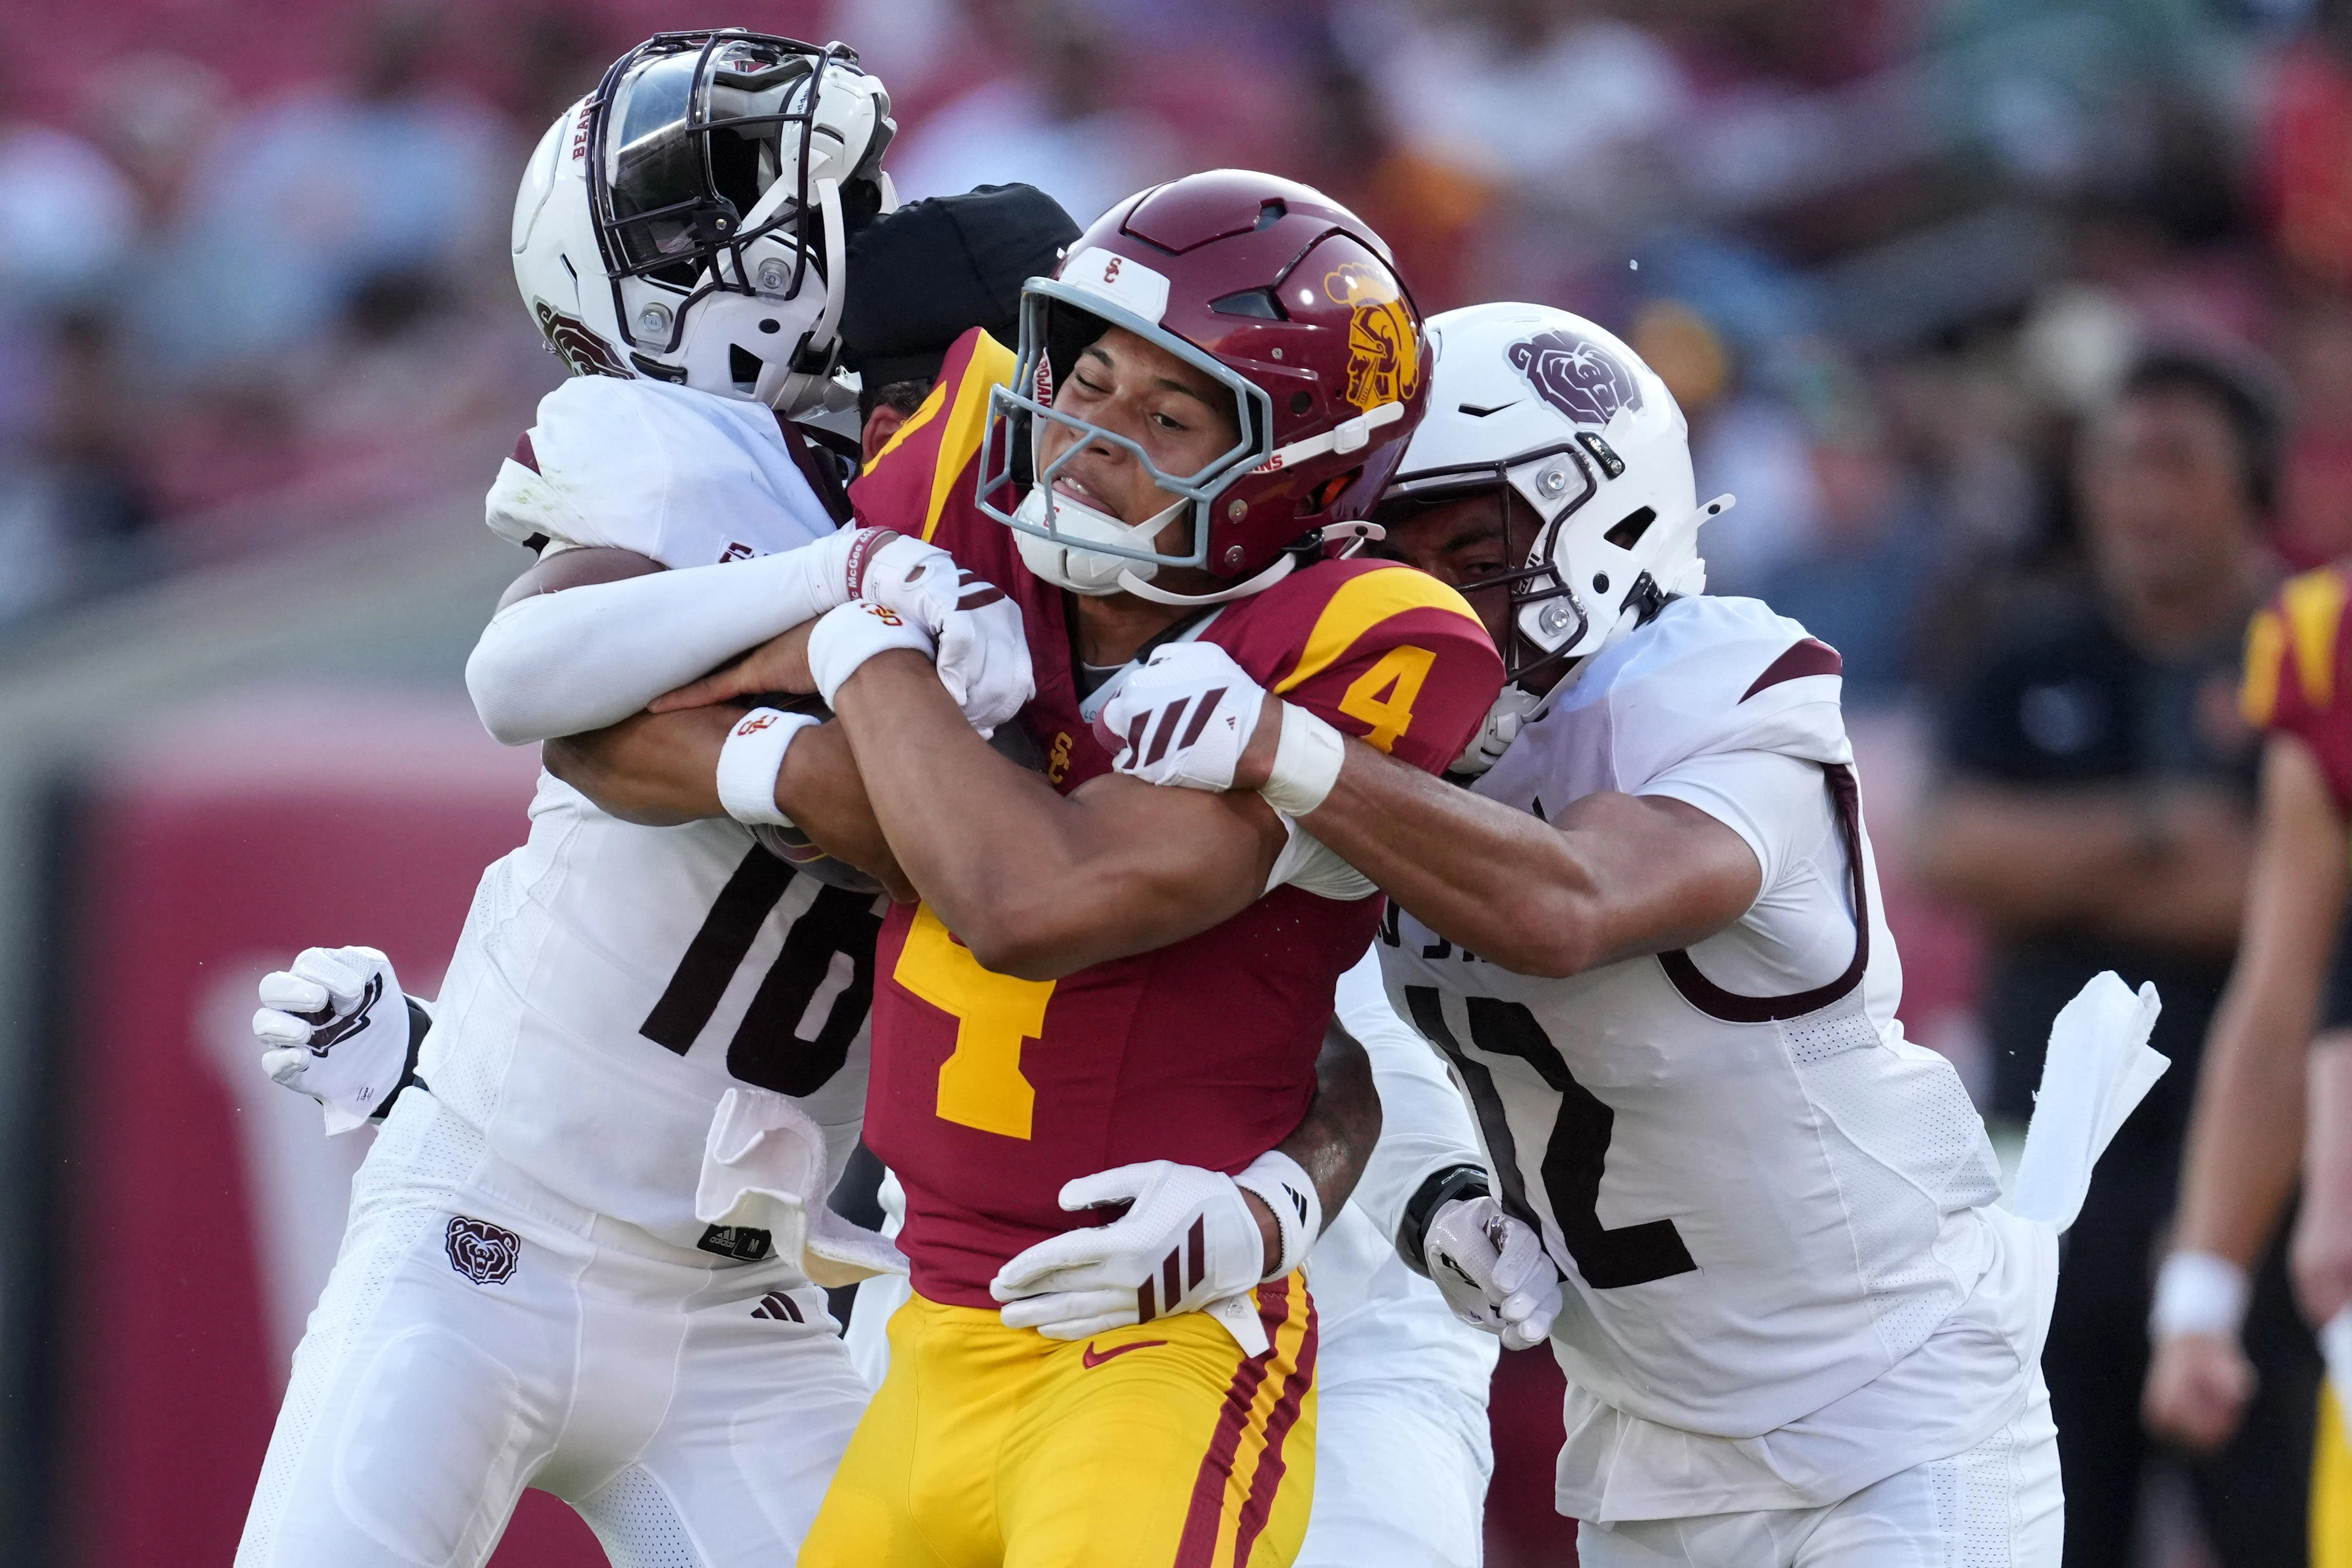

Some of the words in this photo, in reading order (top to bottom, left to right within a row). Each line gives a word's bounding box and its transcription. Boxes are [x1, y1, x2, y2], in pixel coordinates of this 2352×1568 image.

[572, 95, 595, 160] BEARS
[1037, 352, 1052, 418] ROJAN
[848, 544, 863, 588] McGee
[1338, 644, 1437, 754] 4
[1048, 731, 1072, 784] SC
[1404, 984, 1698, 1289] 12
[709, 1236, 736, 1248] adidas
[747, 1238, 760, 1253] M
